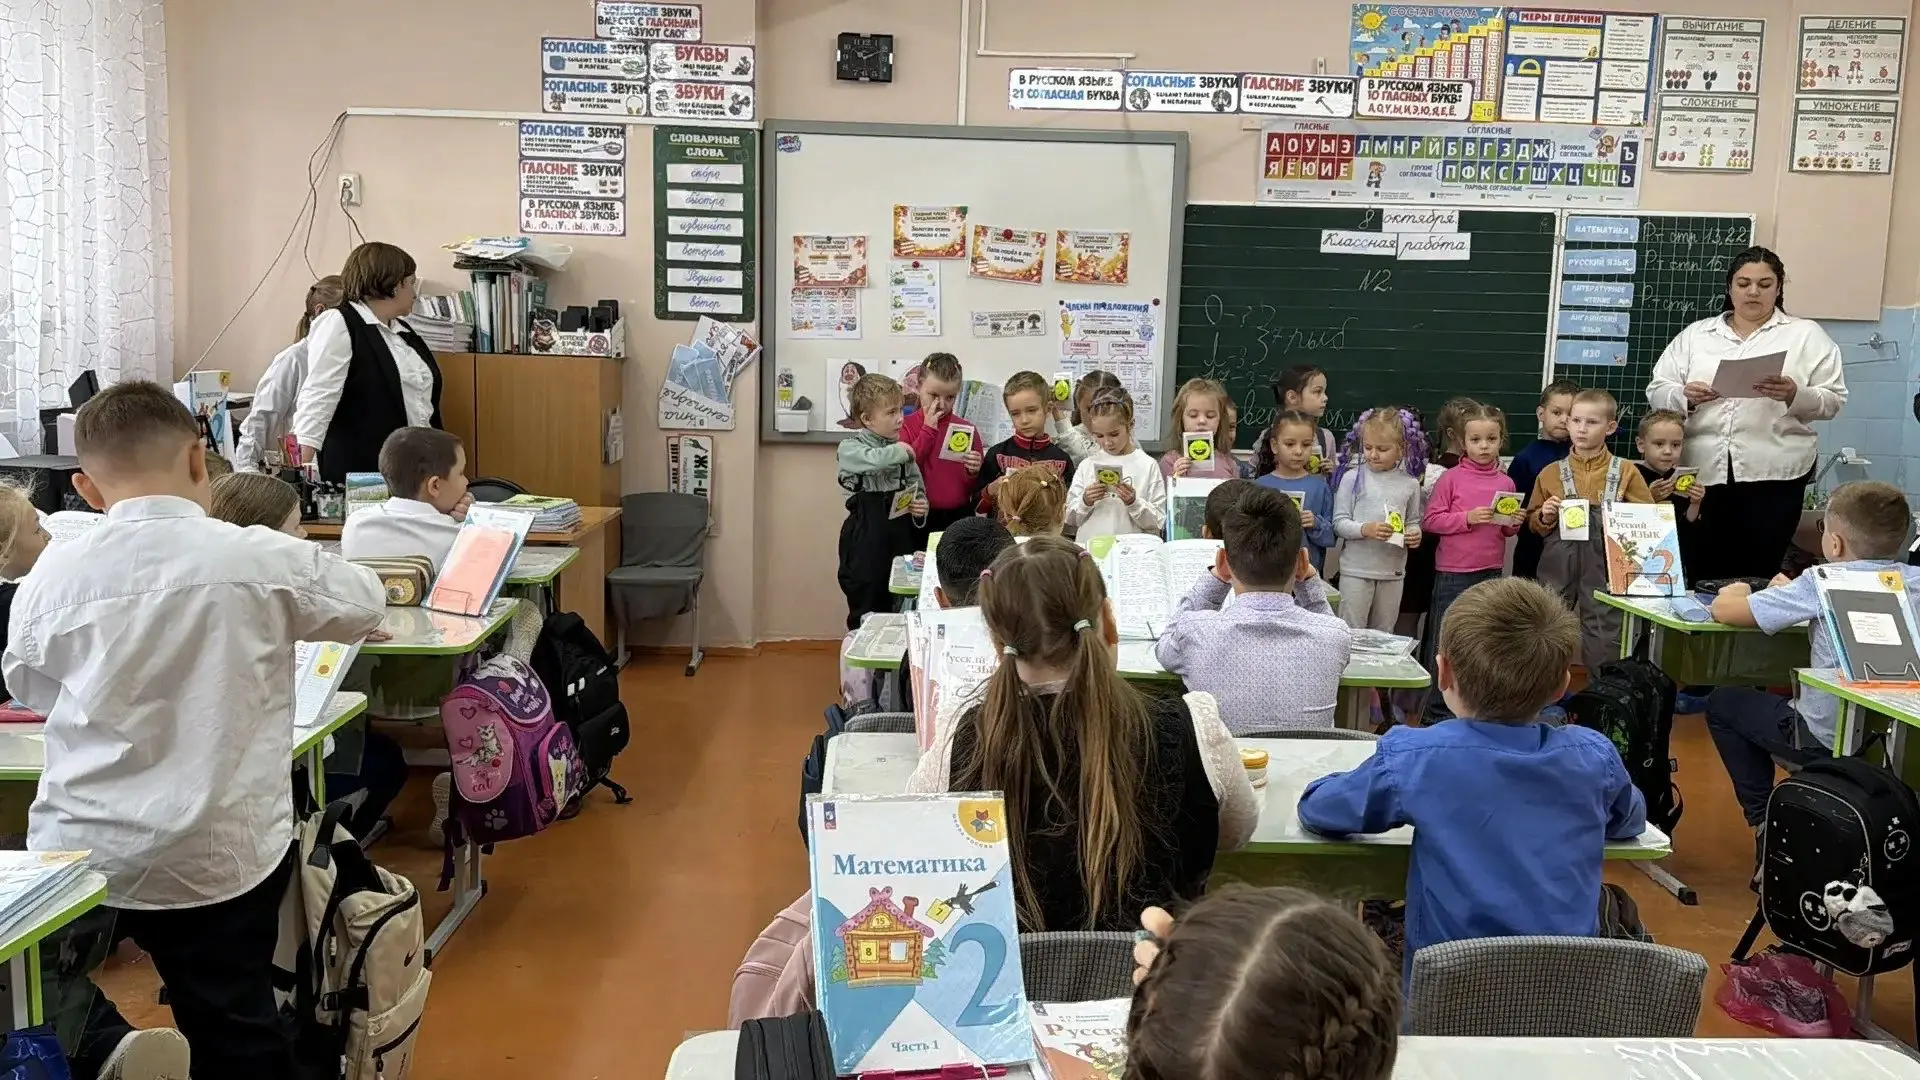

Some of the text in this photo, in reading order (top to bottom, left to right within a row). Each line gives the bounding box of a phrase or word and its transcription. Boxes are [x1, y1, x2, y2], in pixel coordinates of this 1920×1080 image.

[661, 7, 692, 18] ЗВУКИ
[1388, 6, 1480, 19] СОСТАВ ЧИСЛА
[1520, 12, 1602, 24] МЕРЫ ВЕЛИЧИН
[637, 17, 644, 26] С
[645, 17, 699, 28] ГЛАСНЫМИ
[1682, 20, 1745, 31] ВЫЧИТАНИЕ
[1828, 20, 1877, 30] ДЕЛЕНИЕ
[542, 40, 608, 54] СОГЛАСНЫЕ
[1804, 47, 1861, 59] 7 2 3
[674, 45, 730, 62] БУКВЫ
[1674, 48, 1750, 61] 7 3 4
[543, 79, 648, 95] СОГЛАСНЫЕ ЗВУКИ
[1018, 75, 1114, 87] В РУССКОМ ЯЗЫКЕ
[1126, 74, 1239, 89] СОГЛАСНЫЕ ЗВУКИ
[1243, 76, 1354, 94] ГЛАСНЫЕ ЗВУКИ
[1367, 80, 1464, 94] В РУССКОМ ЯЗЫКЕ
[674, 83, 725, 101] ЗВУКИ
[1012, 88, 1120, 101] 21 СОГЛАСНАЯ БУКВА
[1367, 90, 1463, 105] 10 ГЛАСНЫХ БУКВ:
[1680, 97, 1739, 108] СЛОЖЕНИЕ
[1812, 101, 1881, 112] УМНОЖЕНИЕ
[1482, 107, 1493, 117] 10
[520, 123, 625, 140] СОГЛАСНЫЕ ЗВУКИ
[1294, 121, 1331, 131] ГЛАСНЫЕ
[1466, 126, 1513, 135] СОГЛАСНЫЕ
[1668, 125, 1747, 138] 3 4 7
[669, 133, 741, 145] СЛОВАРНЫЕ
[1807, 129, 1882, 142] 2 4 8
[685, 147, 725, 158] СЛОВА
[1269, 137, 1549, 160] А О У Ы Э Л М Н Р Й Б В Г З Д Ж
[1622, 145, 1635, 162] Ъ
[1559, 151, 1594, 159] СОГЛАСНЫЕ
[521, 161, 623, 178] ГЛАСНЫЕ ЗВУКИ
[1268, 158, 1632, 187] Я Ё Ю И Е П Ф К С Т Ш Х Ц Ч Щ Ь
[1410, 163, 1434, 171] ГЛУХИЕ
[1398, 170, 1433, 178] СОГЛАСНЫЕ
[1464, 183, 1524, 192] ПАРНЫЕ СОГЛАСНЫЕ
[528, 199, 617, 212] В РУССКОМ ЯЗЫКЕ
[525, 208, 620, 221] 6 ГЛАСНЫХ ЗВУКОВ:
[1358, 208, 1375, 230] 8
[1574, 224, 1630, 235] МАТЕМАТИКА
[1322, 232, 1397, 249] Классная
[1568, 256, 1631, 267] РУССКИЙ ЯЗЫК
[1570, 283, 1627, 293] ЛИТЕРАТУРНОЕ
[1065, 302, 1092, 311] ЧЛЕНЫ
[1583, 296, 1612, 305] ЧТЕНИЕ
[1570, 313, 1618, 323] АНГЛИЙСКИЙ
[1581, 326, 1602, 334] ЯЗЫК
[1581, 348, 1601, 359] ИЗО
[1608, 517, 1648, 530] Русский
[1652, 548, 1679, 585] 2
[832, 852, 987, 876] Математика
[935, 907, 944, 917] 7
[875, 917, 886, 926] 15
[865, 947, 873, 957] 8
[949, 922, 1021, 1028] 2
[891, 1039, 942, 1053] Часть 1
